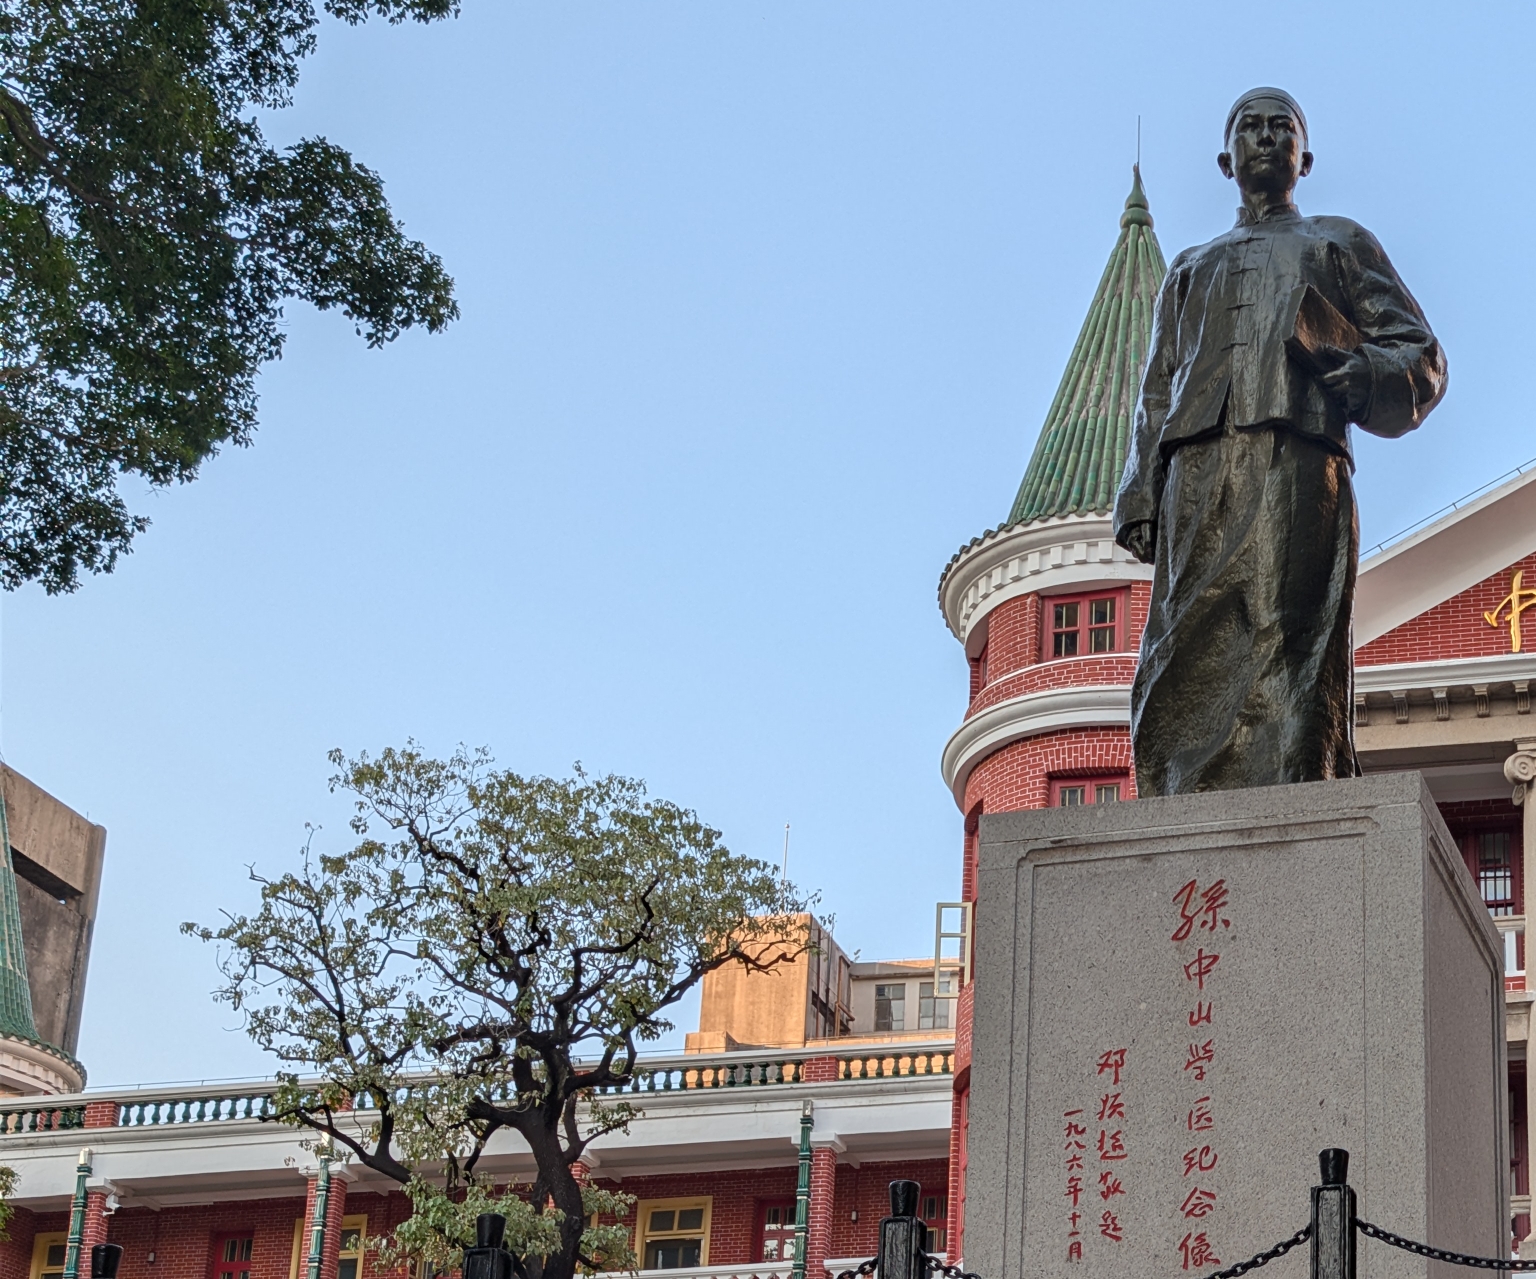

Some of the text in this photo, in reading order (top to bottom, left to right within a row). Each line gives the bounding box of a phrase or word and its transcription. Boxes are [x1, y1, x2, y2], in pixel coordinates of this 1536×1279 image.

[1063, 1108, 1086, 1260] 一九八六年十一月
[1096, 1048, 1128, 1242] 邓颖超敬题
